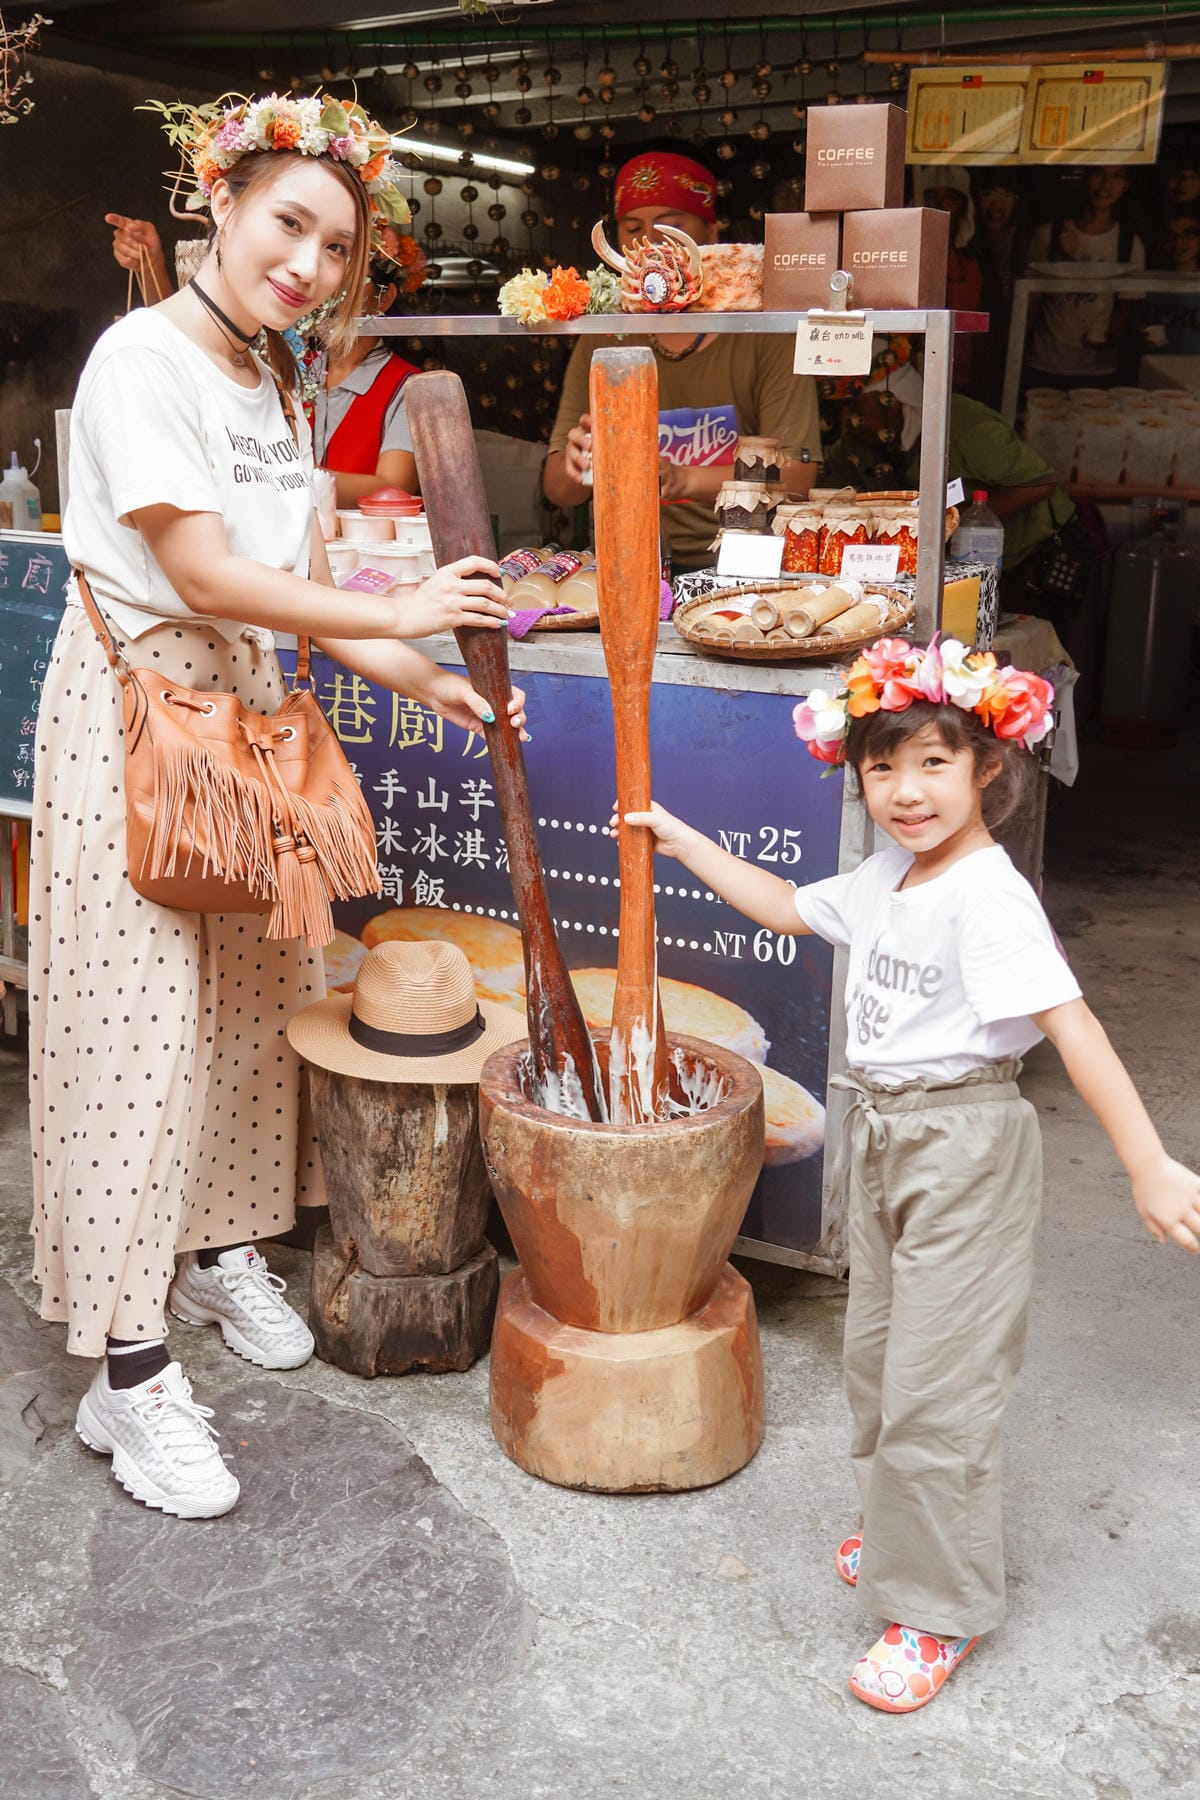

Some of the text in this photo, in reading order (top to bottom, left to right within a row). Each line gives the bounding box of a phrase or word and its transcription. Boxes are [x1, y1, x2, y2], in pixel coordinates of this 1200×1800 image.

[817, 148, 875, 161] COFFEE
[774, 254, 826, 266] COFFEE
[853, 251, 908, 263] COFFEE
[267, 438, 300, 465] YOU
[234, 463, 252, 484] GO
[275, 471, 309, 491] YOUR
[347, 762, 495, 822] 手山芋
[718, 825, 802, 865] NT 25
[377, 862, 449, 909] 筒飯
[713, 928, 798, 966] NT 60
